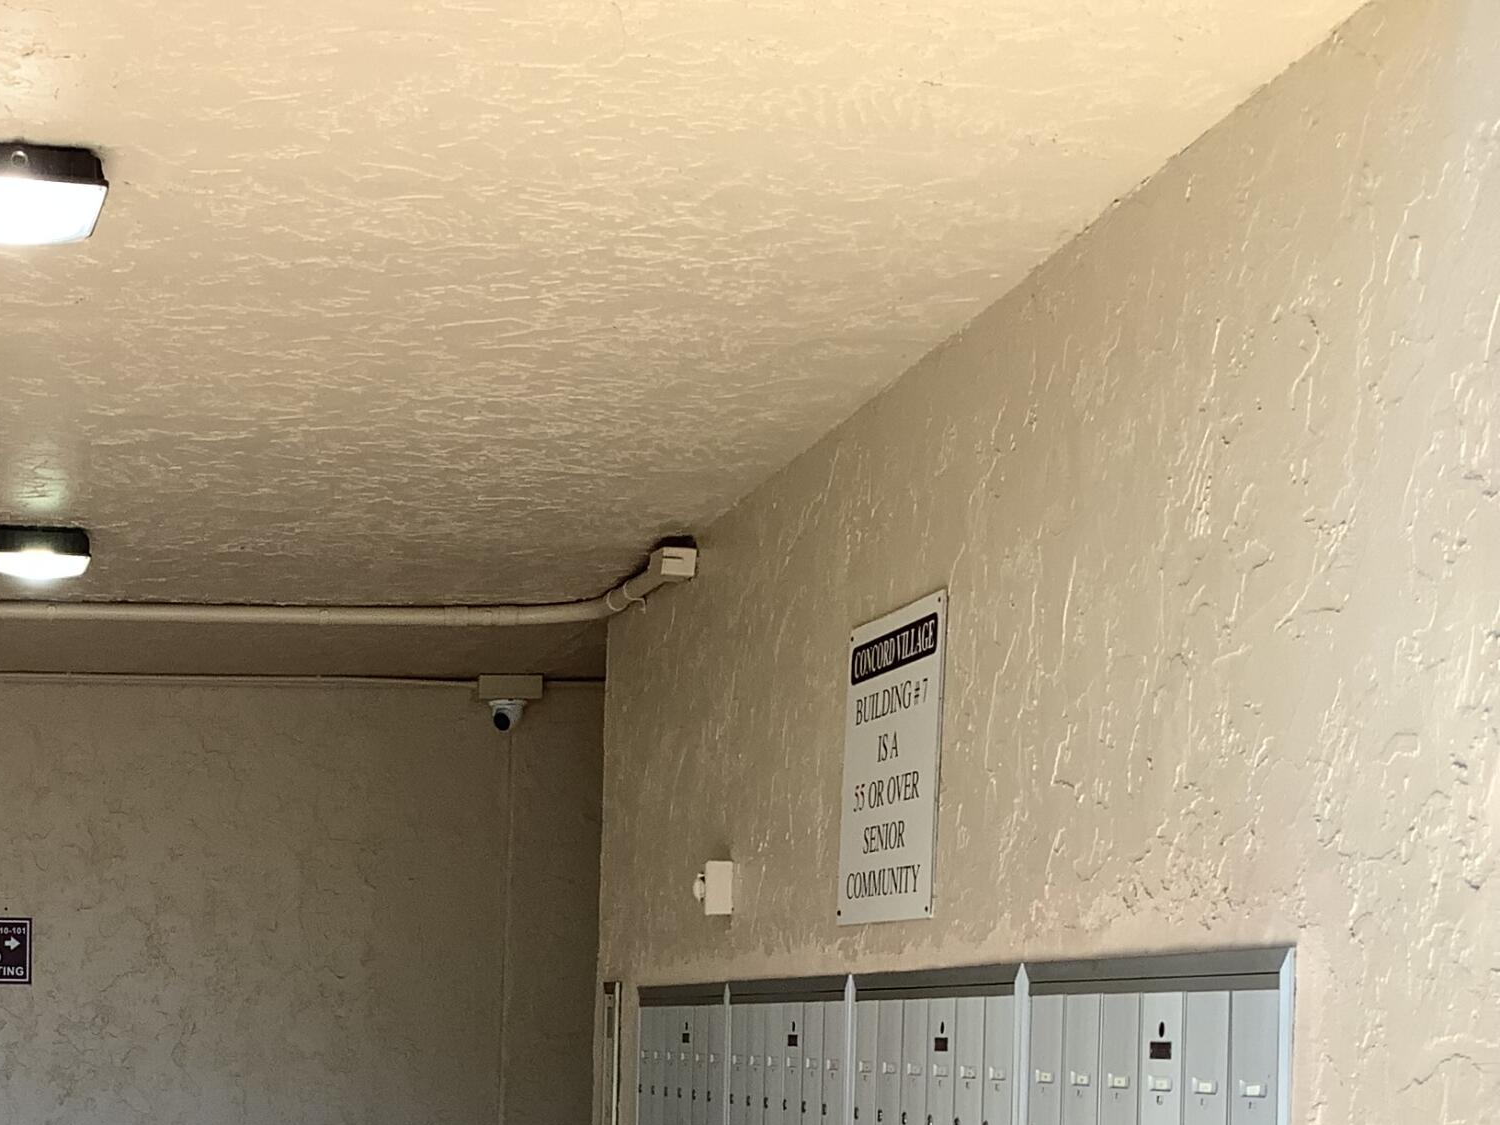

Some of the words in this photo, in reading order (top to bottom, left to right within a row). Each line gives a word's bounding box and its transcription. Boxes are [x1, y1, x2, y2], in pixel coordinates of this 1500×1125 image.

[854, 637, 895, 679] CONCORD
[896, 619, 935, 662] VILLAGE
[855, 680, 912, 726] BUILDING
[877, 733, 888, 763] IS
[889, 730, 899, 760] A
[853, 783, 866, 812] 55
[867, 779, 884, 809] OR
[886, 770, 920, 805] OVER
[862, 819, 906, 855] SENIOR
[845, 863, 921, 900] COMMUNITY
